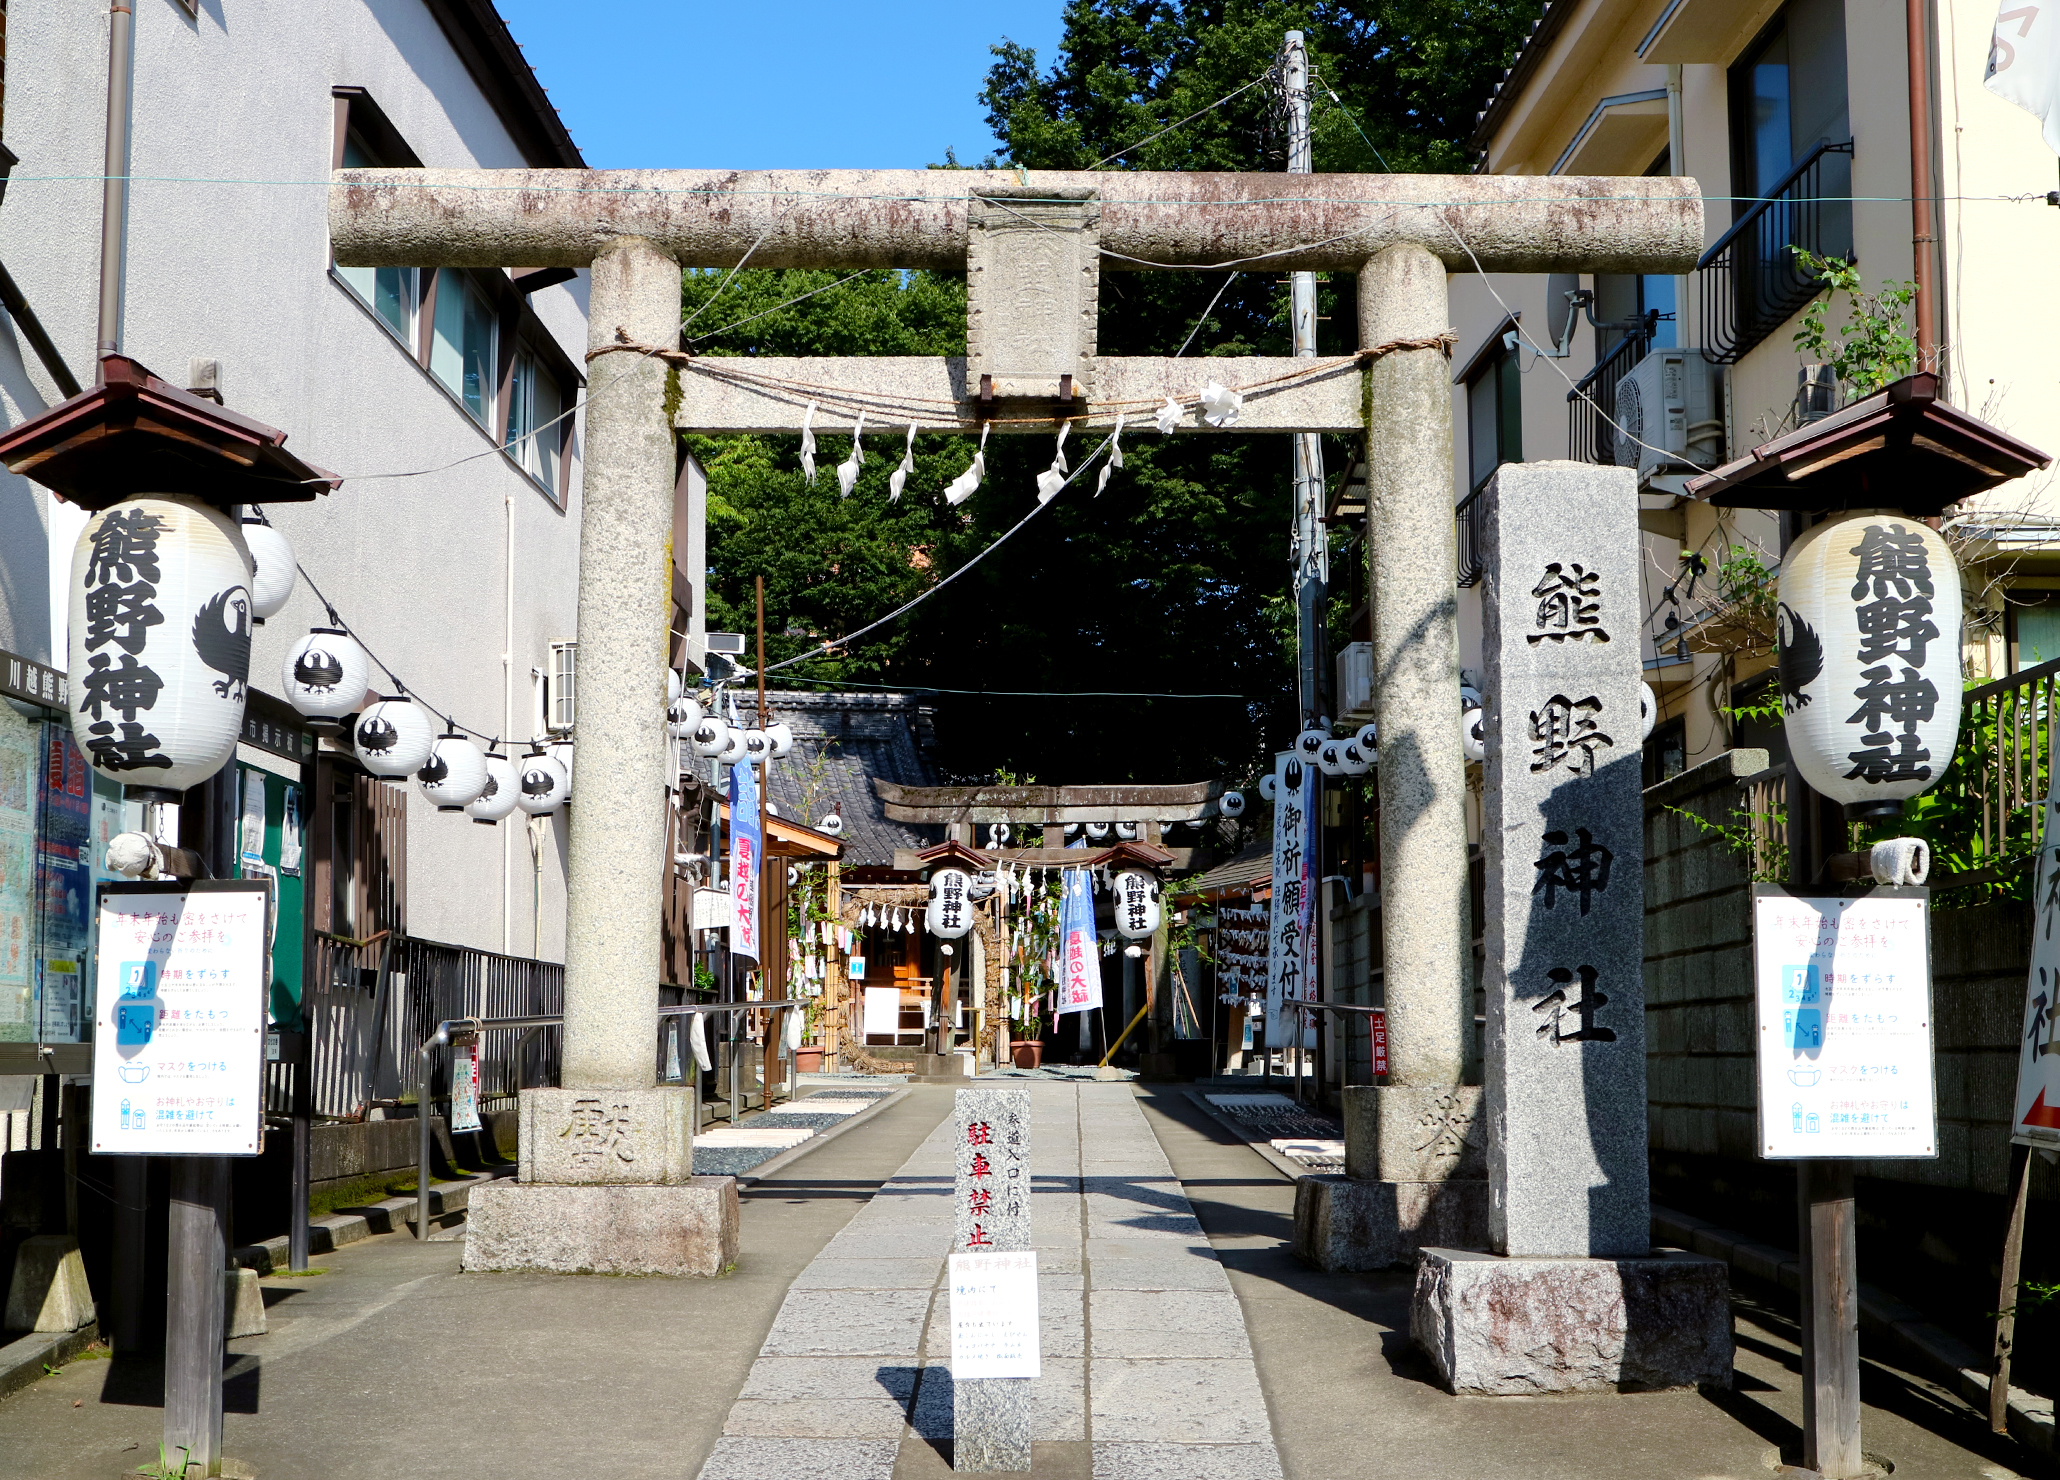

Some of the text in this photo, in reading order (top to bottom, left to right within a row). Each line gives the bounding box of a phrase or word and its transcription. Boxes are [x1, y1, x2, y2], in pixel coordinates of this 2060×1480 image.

[80, 507, 173, 771] 熊野神社
[1843, 524, 1940, 784] 熊野神社
[9, 658, 68, 706] 川越熊野
[240, 718, 294, 753] 市掲示板
[1526, 562, 1617, 1043] 熊野神社
[942, 872, 963, 929] 熊野神社
[1125, 874, 1147, 931] 熊野神社
[1278, 802, 1302, 1000] 御祈願受付
[117, 911, 248, 927] 年末年始も密をさけて
[1774, 916, 1909, 931] 年末年始も密をさけて
[134, 929, 228, 945] 安心のご参拝を
[1795, 934, 1888, 949] 安心のご参拝を
[161, 968, 231, 981] 時期をずらす
[1824, 973, 1896, 984] 時期をずらす
[159, 1008, 229, 1020] 距離をたもつ
[1826, 1013, 1898, 1025] 距離をたもつ
[1374, 1017, 1387, 1072] 土足厳禁
[156, 1061, 227, 1072] マスクをつける
[1828, 1065, 1899, 1075] マスクをつける
[155, 1096, 236, 1108] お神札やお守りは
[1829, 1100, 1909, 1111] お神札やお守りは
[155, 1109, 215, 1121] 混雑を避けて
[1829, 1113, 1889, 1124] 混雑を避けて
[1006, 1112, 1022, 1217] 参道入口に付
[966, 1121, 994, 1248] 駐車禁止
[954, 1257, 1033, 1272] 熊野神社
[956, 1284, 997, 1296] 境内にて
[957, 1320, 1013, 1329] 屋台も出ています
